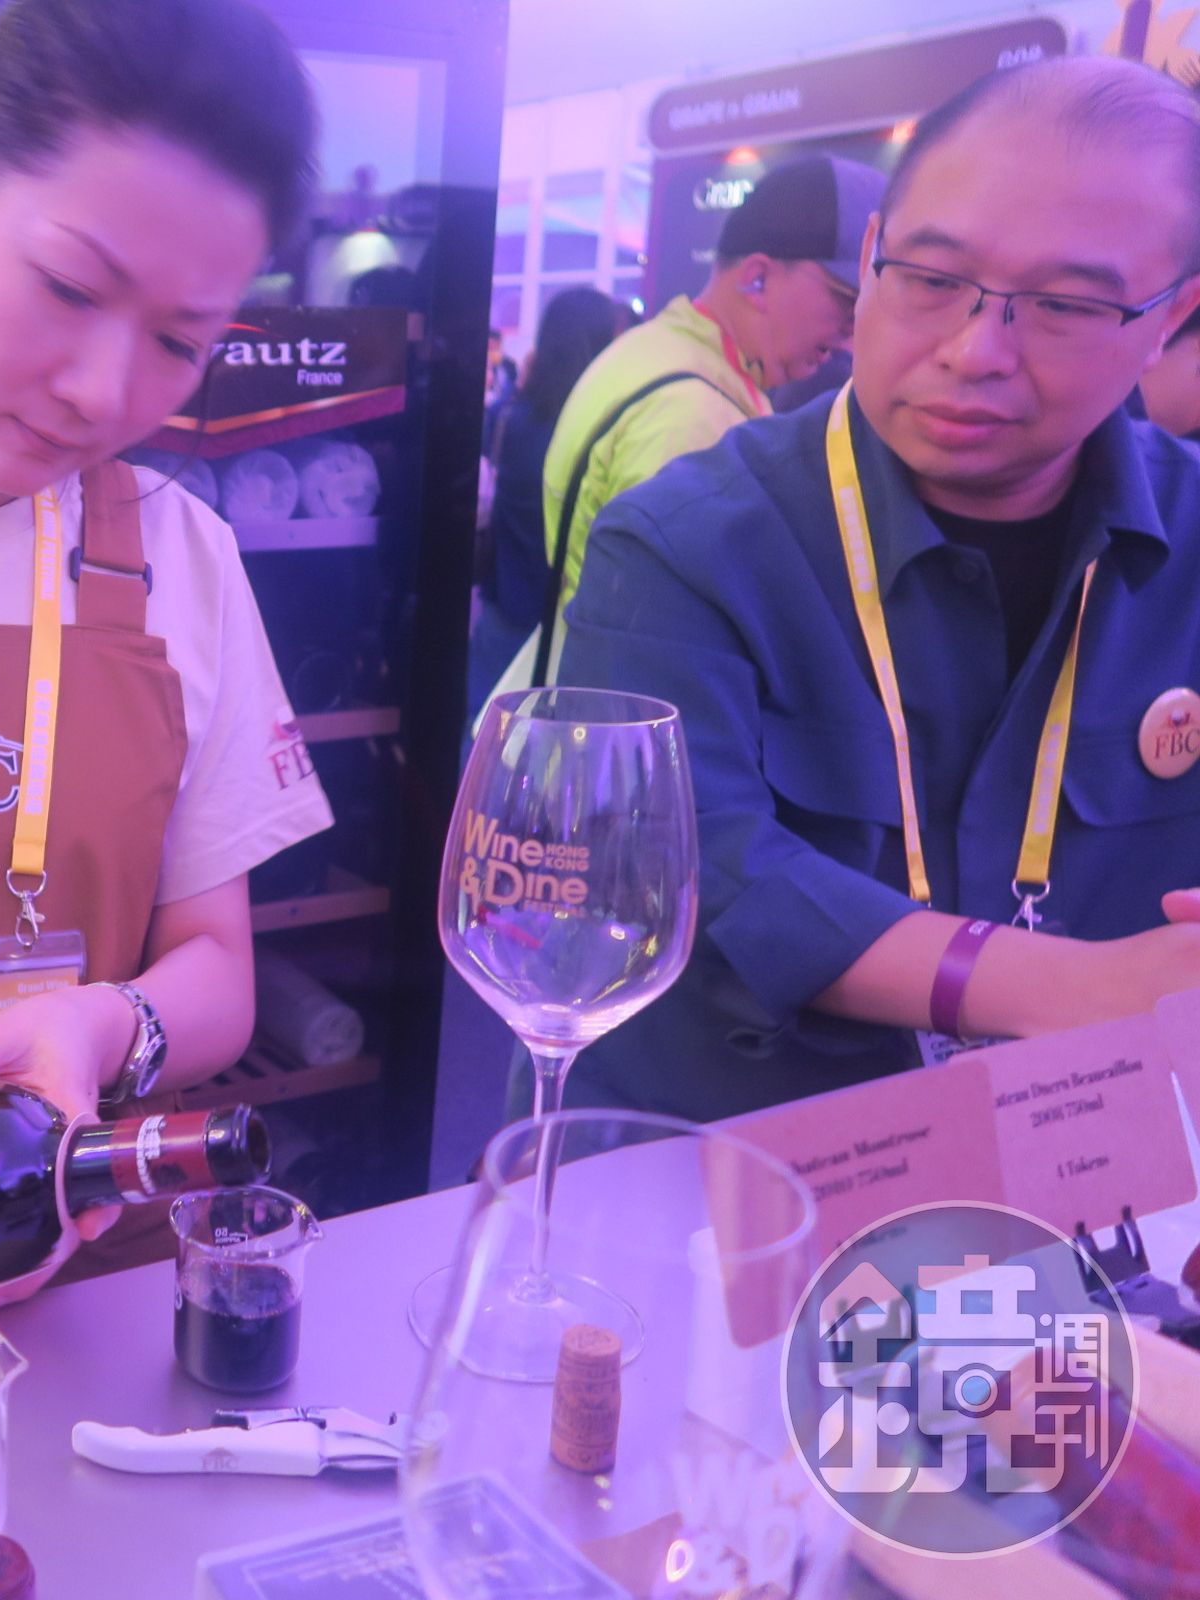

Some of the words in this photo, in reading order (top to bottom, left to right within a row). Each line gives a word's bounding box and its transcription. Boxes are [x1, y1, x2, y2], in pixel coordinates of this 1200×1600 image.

[296, 369, 344, 386] France
[1154, 729, 1200, 760] FBC
[463, 807, 545, 868] Wine
[545, 843, 590, 859] HONG
[544, 857, 590, 872] KONG
[484, 858, 588, 905] Dine
